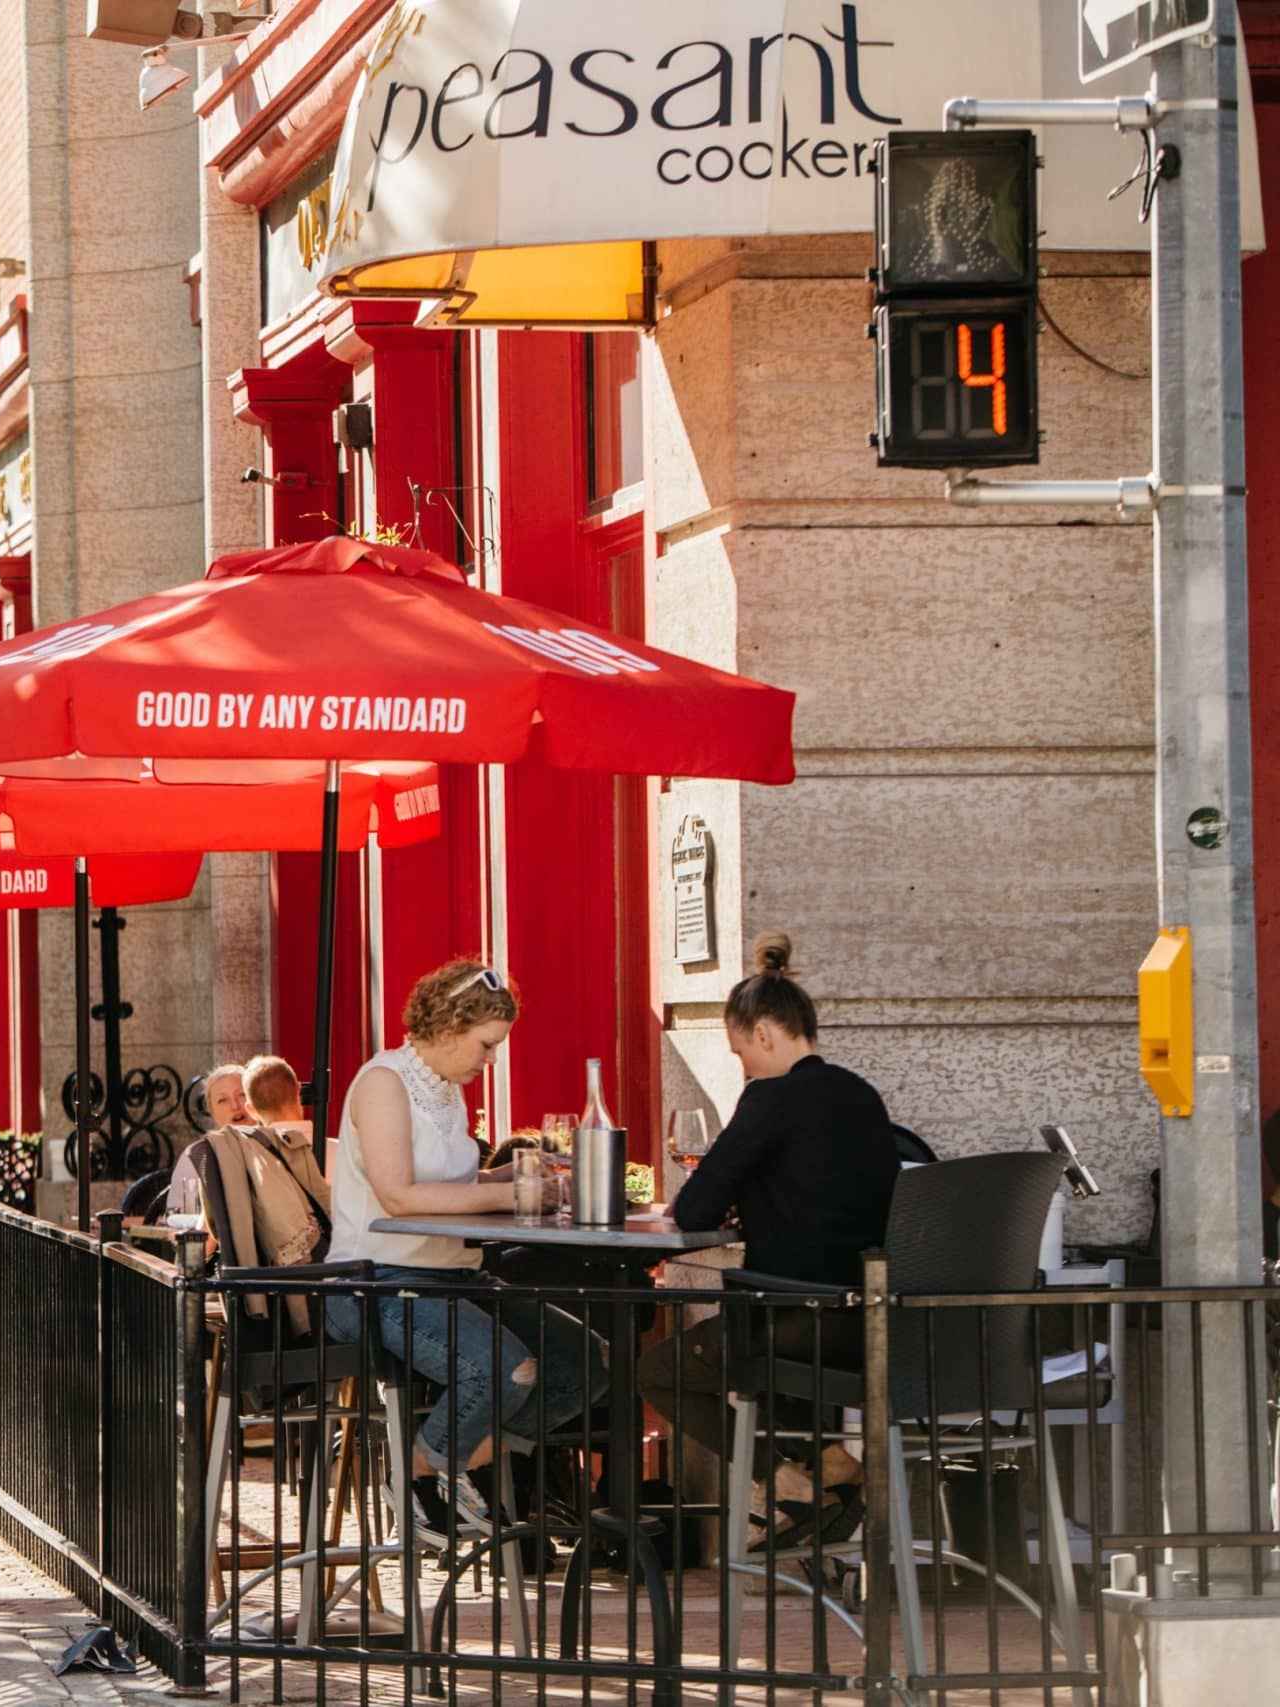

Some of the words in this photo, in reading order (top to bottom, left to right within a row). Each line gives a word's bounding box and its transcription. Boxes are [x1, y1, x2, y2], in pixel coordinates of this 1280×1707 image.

[366, 3, 903, 213] peasant
[657, 93, 868, 185] cooker
[957, 321, 1007, 436] 4
[481, 621, 661, 676] 1919
[136, 691, 210, 727] GOOD
[217, 693, 253, 728] BY
[259, 694, 315, 729] ANY
[320, 695, 466, 733] STANDARD
